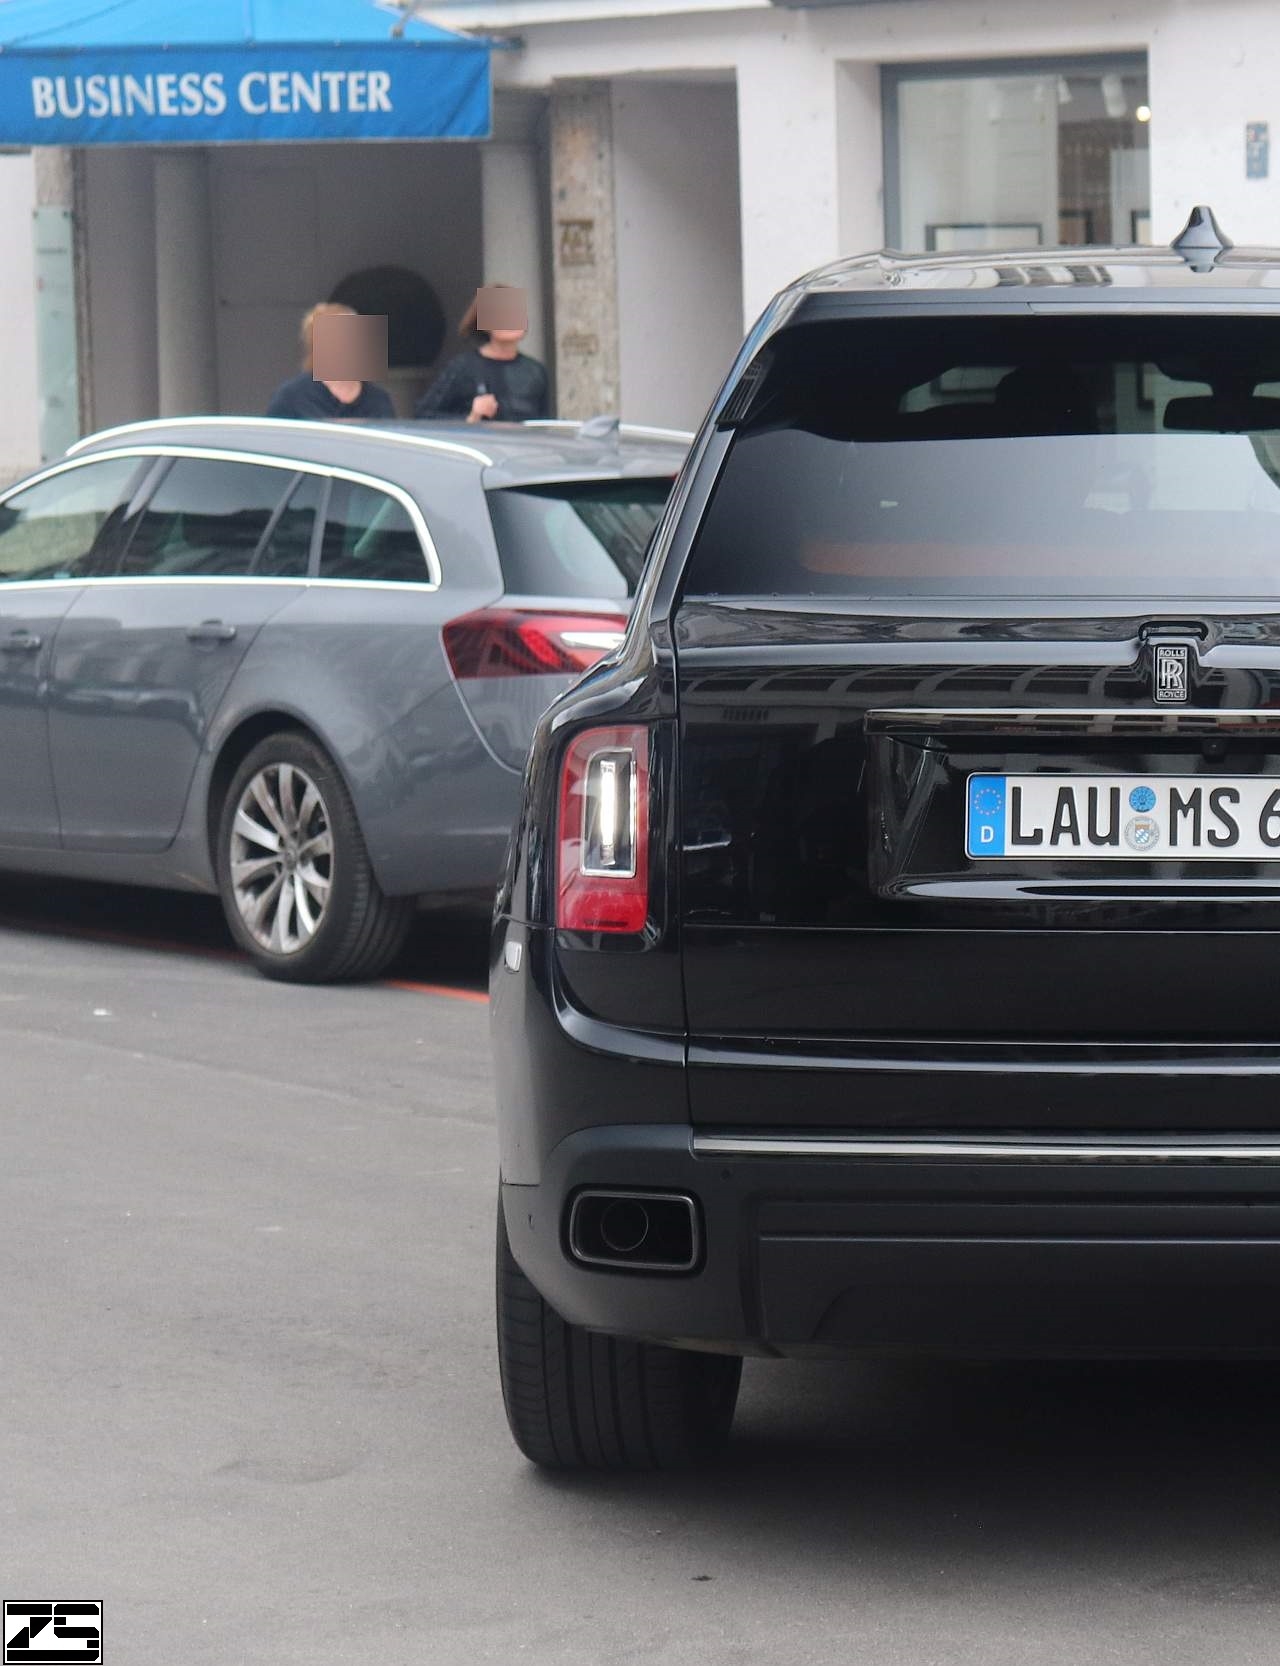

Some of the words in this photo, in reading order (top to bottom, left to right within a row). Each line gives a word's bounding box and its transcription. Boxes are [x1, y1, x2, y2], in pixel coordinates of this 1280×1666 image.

[32, 73, 227, 119] BUSINESS
[238, 71, 393, 115] CENTER
[1159, 648, 1185, 657] ROLLS
[1159, 690, 1185, 698] ROYCE
[1010, 786, 1120, 846] LAU
[1168, 787, 1240, 848] MS
[979, 825, 995, 844] D
